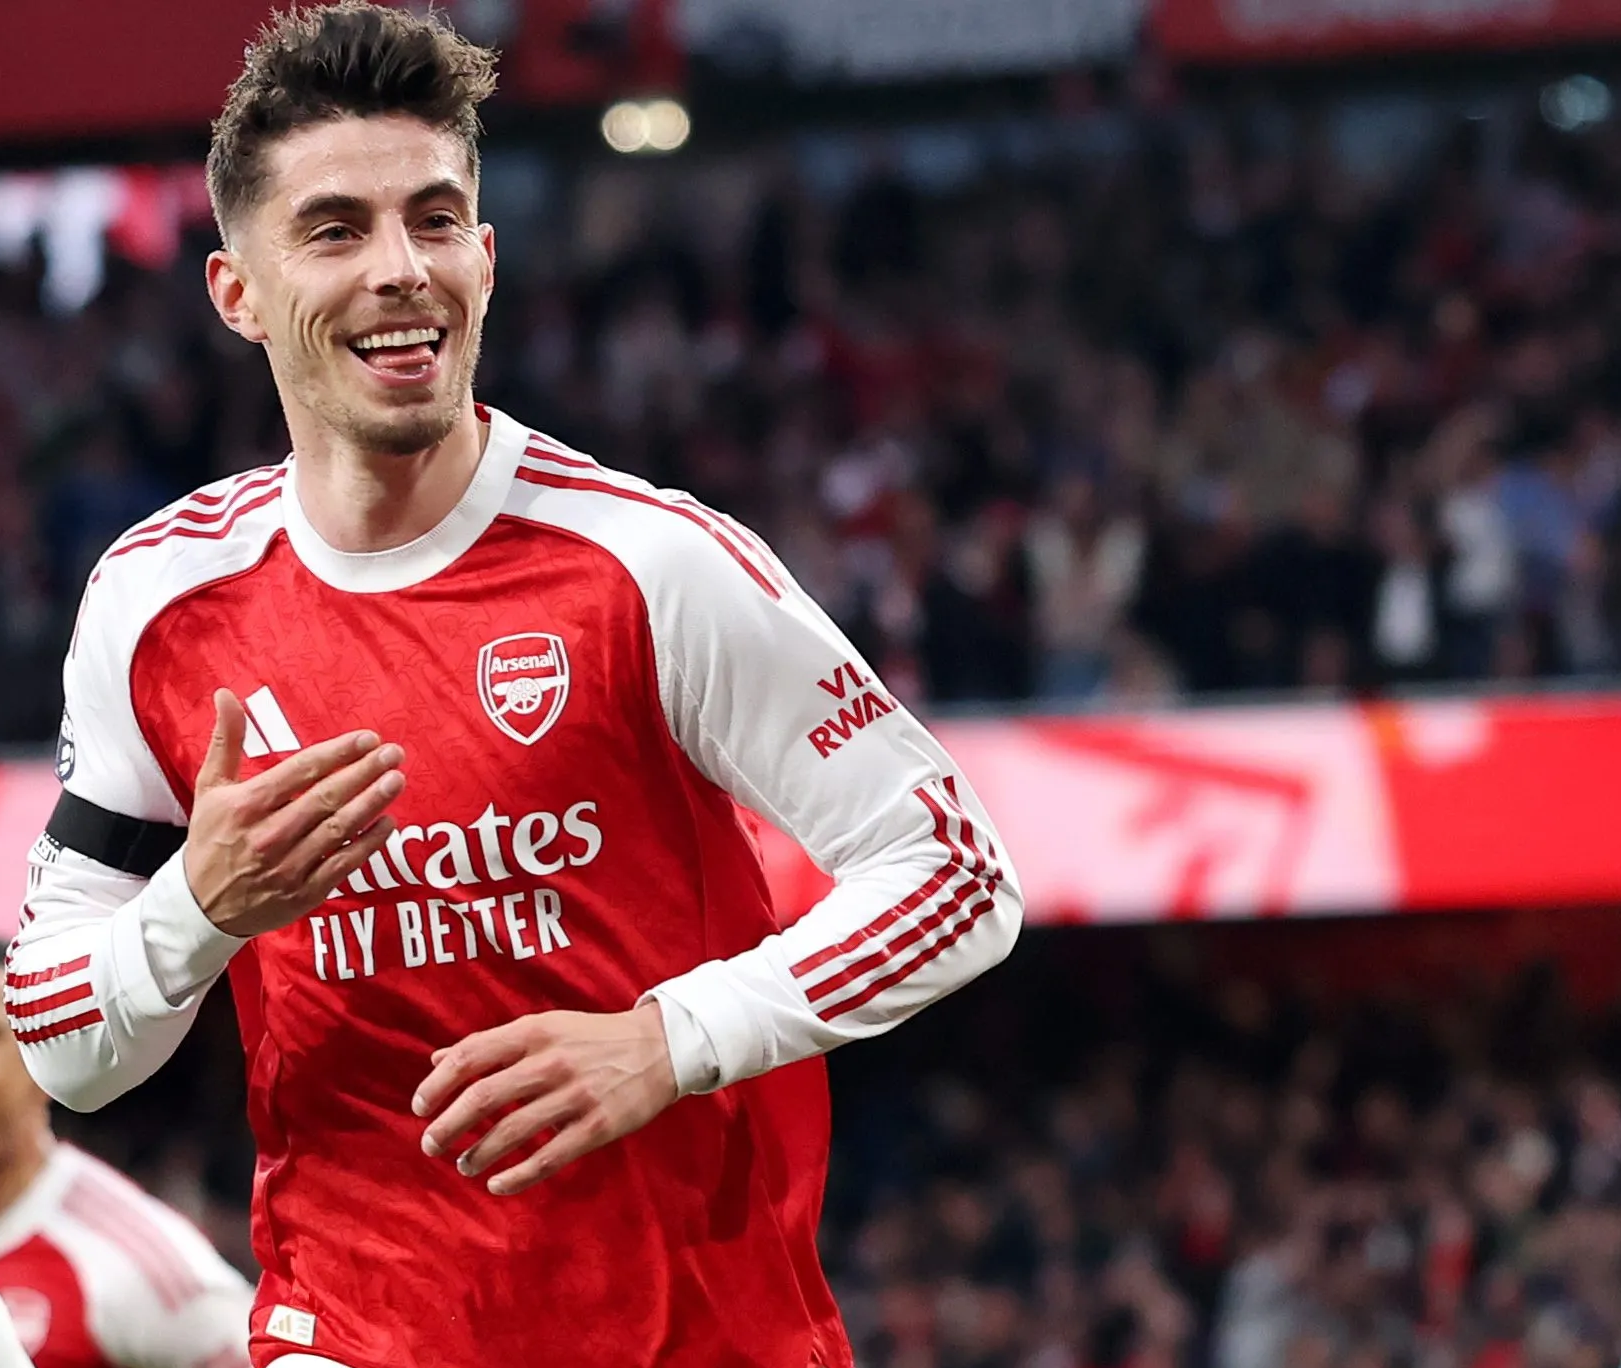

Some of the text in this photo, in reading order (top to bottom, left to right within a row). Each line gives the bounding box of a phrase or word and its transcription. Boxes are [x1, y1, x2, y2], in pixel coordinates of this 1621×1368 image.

[490, 649, 556, 674] Arsenal
[807, 690, 898, 760] RWA
[326, 800, 603, 900] irates
[309, 887, 572, 981] FLY BETTER
